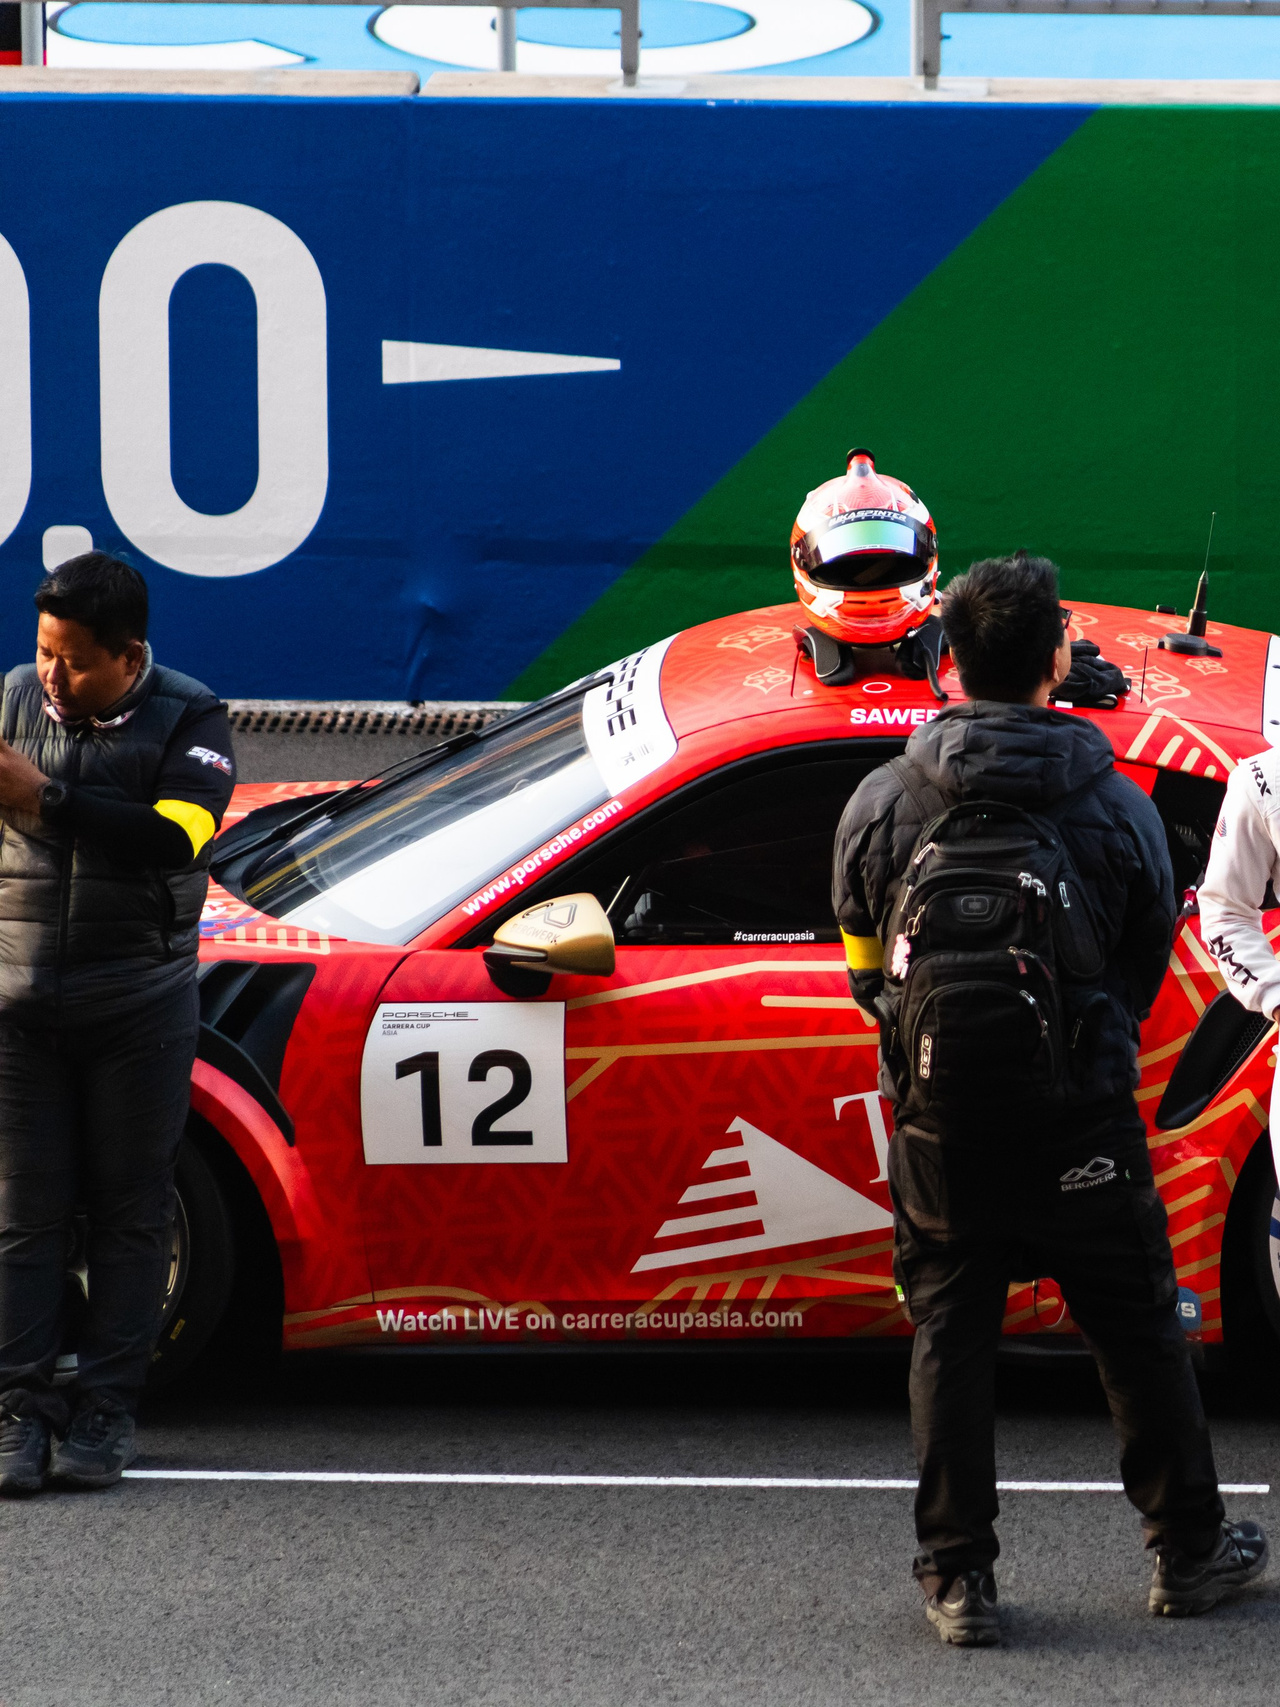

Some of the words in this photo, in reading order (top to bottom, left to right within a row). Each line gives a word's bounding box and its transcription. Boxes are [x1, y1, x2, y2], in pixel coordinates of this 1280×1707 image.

[1249, 760, 1272, 797] HRX
[461, 799, 624, 917] www.porsche.com
[511, 923, 561, 945] BERGWERK
[733, 930, 815, 943] #carreracupasia
[920, 1034, 933, 1079] OGIO
[395, 1048, 534, 1147] 12
[1061, 1170, 1118, 1192] BERGWERK
[376, 1307, 457, 1332] Watch
[464, 1307, 519, 1330] LIVE
[526, 1312, 556, 1330] on
[561, 1306, 803, 1334] carreracupasia.com
